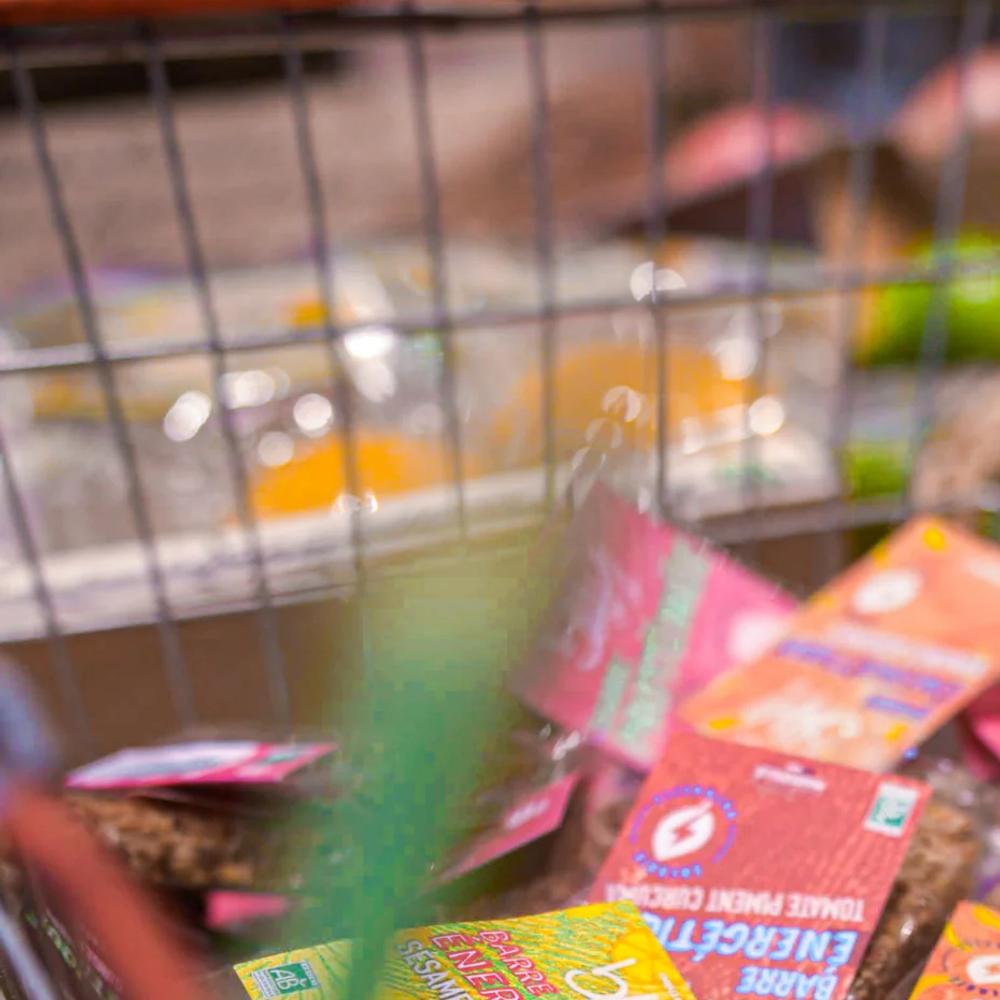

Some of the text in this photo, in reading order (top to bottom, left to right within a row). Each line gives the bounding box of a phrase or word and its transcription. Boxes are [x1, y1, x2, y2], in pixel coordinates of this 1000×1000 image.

[704, 887, 784, 917] PIMENT
[786, 894, 865, 923] TOMATE
[477, 928, 560, 998] BARRE
